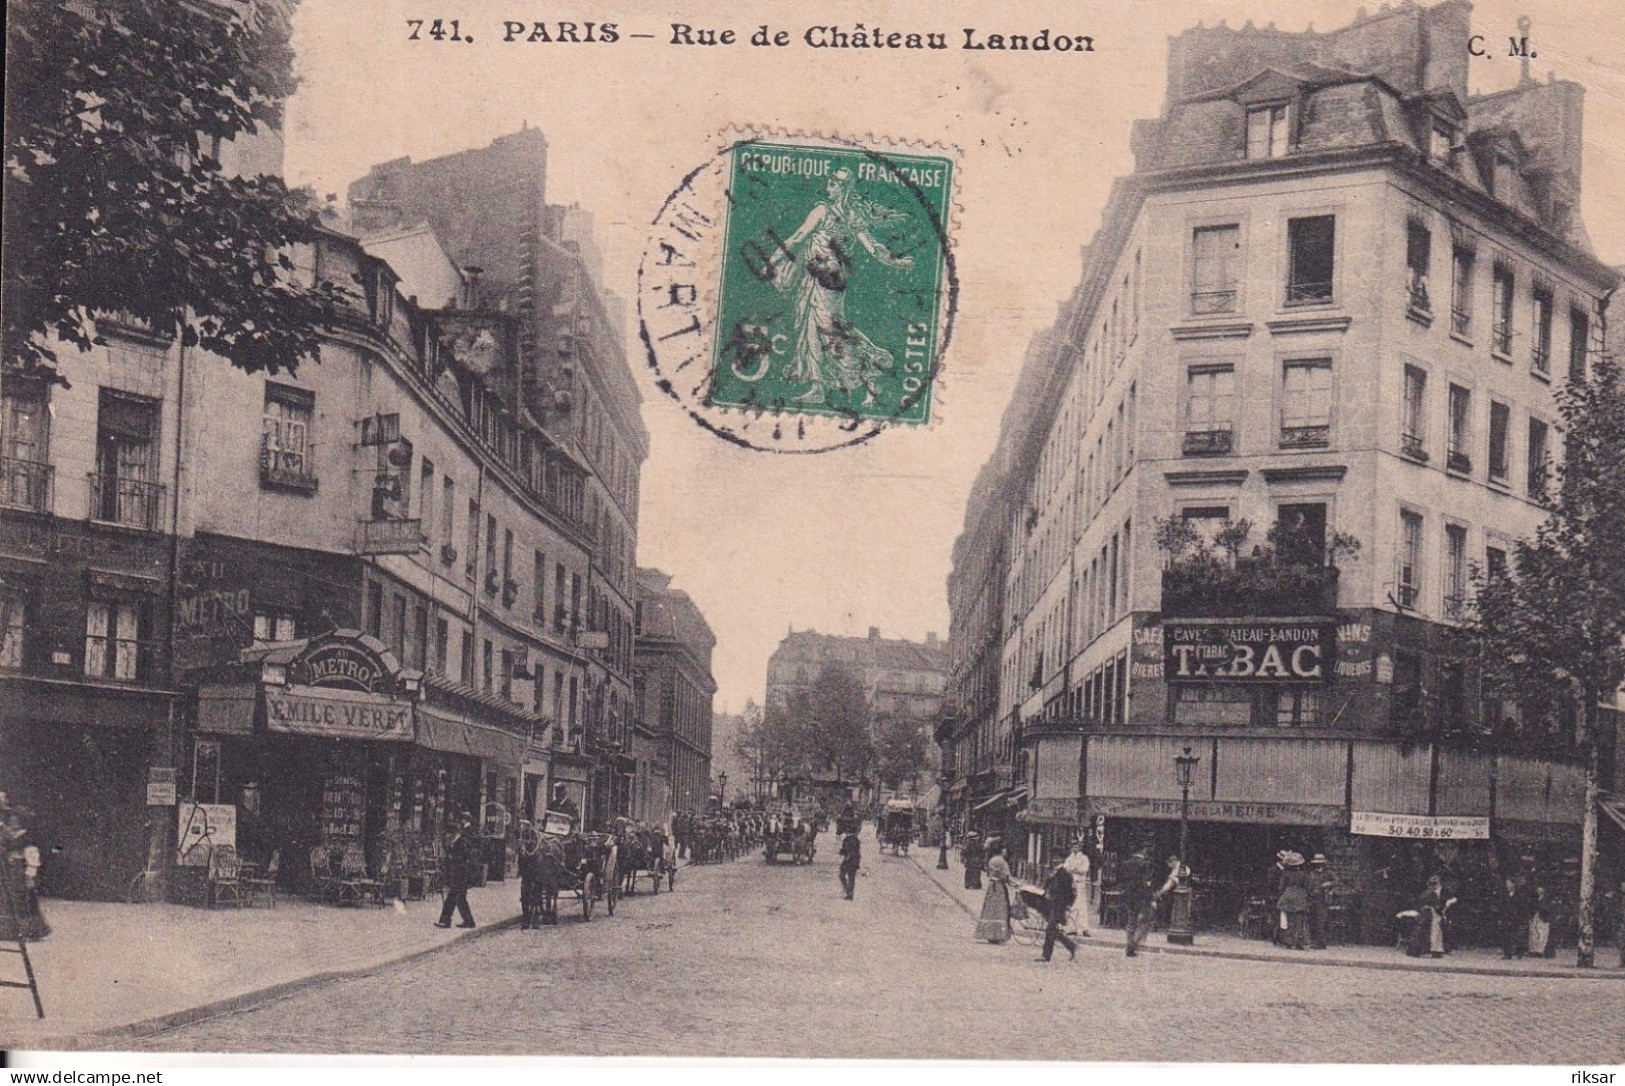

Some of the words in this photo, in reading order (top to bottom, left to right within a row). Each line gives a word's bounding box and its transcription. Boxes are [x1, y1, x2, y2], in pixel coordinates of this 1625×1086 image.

[406, 18, 475, 43] 741.
[502, 21, 620, 43] PARIS
[669, 23, 737, 46] Rue
[750, 24, 790, 47] de
[803, 23, 948, 50] Château
[961, 27, 1095, 52] Landon
[1467, 35, 1492, 60] C.
[1508, 36, 1538, 59] M.
[900, 321, 929, 409] POSTES
[1336, 623, 1373, 642] VINS
[1202, 645, 1229, 659] TABAC
